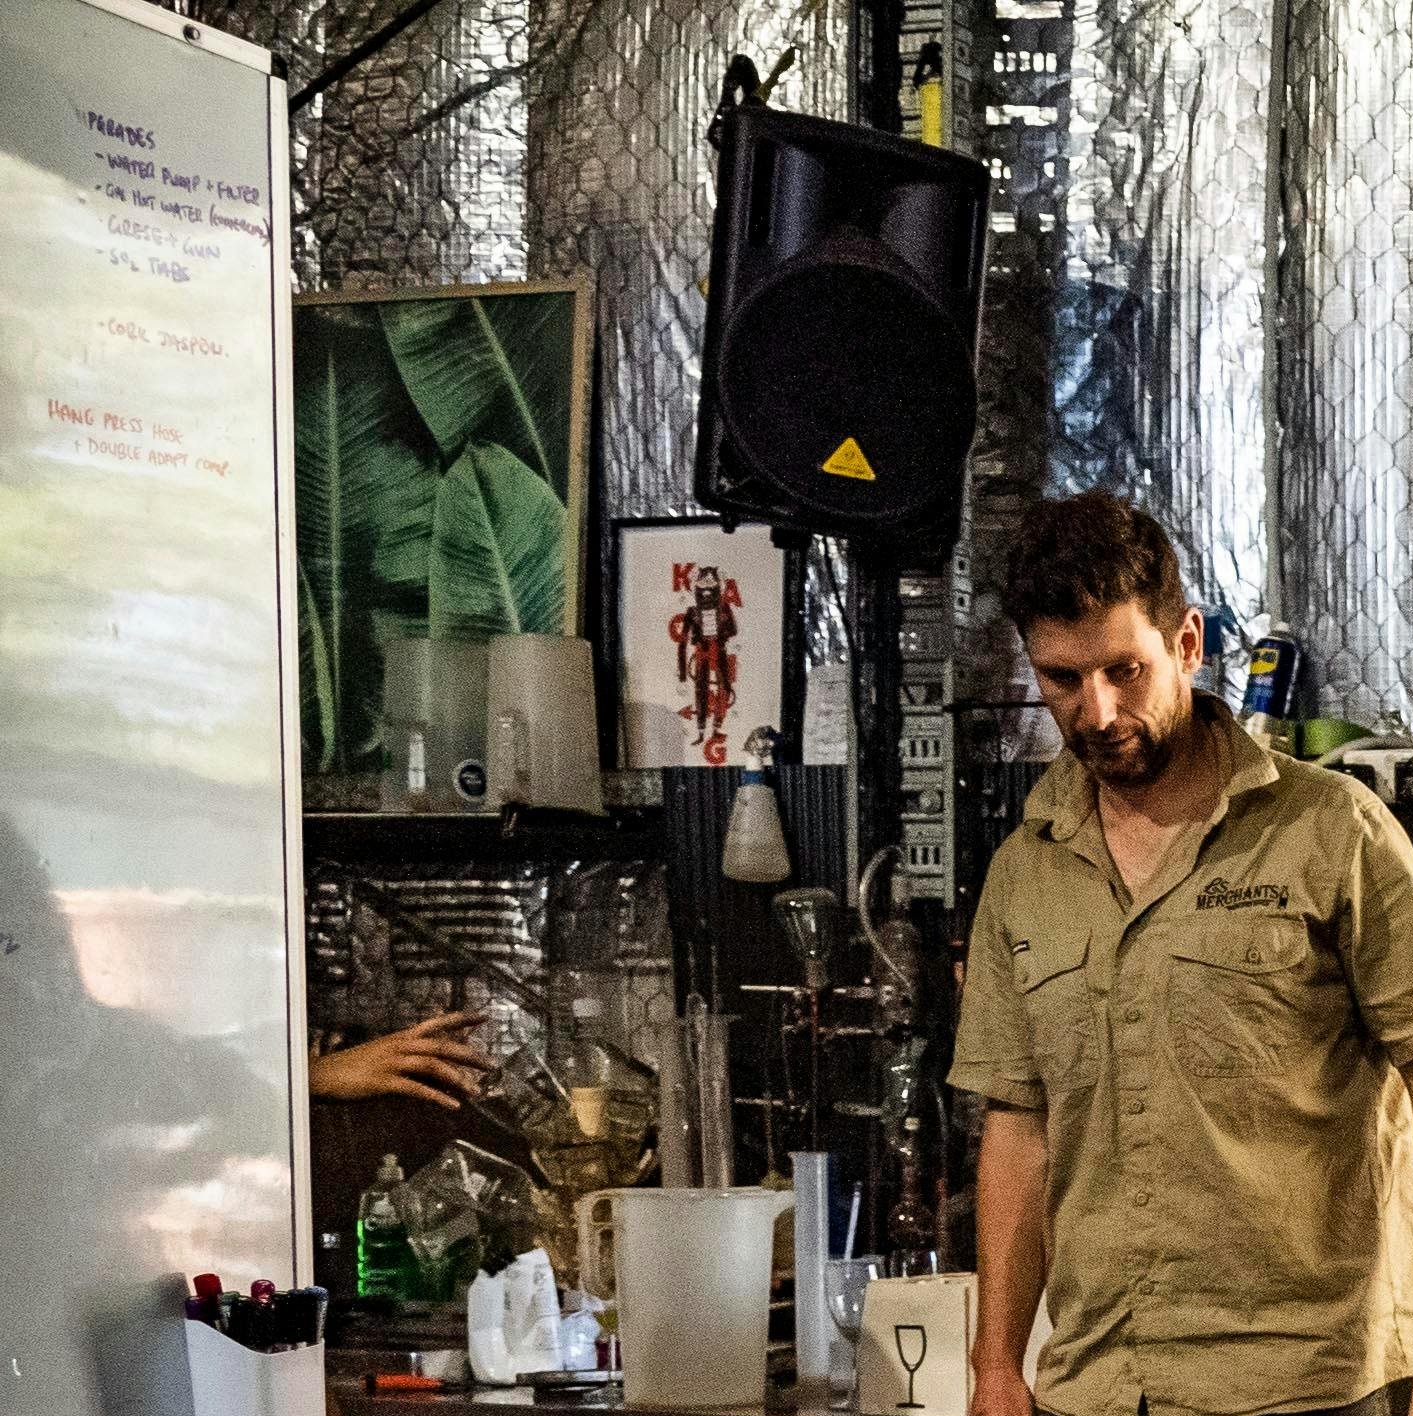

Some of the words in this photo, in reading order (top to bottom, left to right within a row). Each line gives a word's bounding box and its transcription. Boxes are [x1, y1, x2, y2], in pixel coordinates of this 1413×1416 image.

[47, 398, 95, 426] HANG
[103, 412, 144, 434] PRESS
[152, 424, 184, 445] HOSE
[88, 437, 142, 461] DOUBLE
[149, 452, 189, 469] ADAPT
[1195, 884, 1279, 911] MERCHANTS
